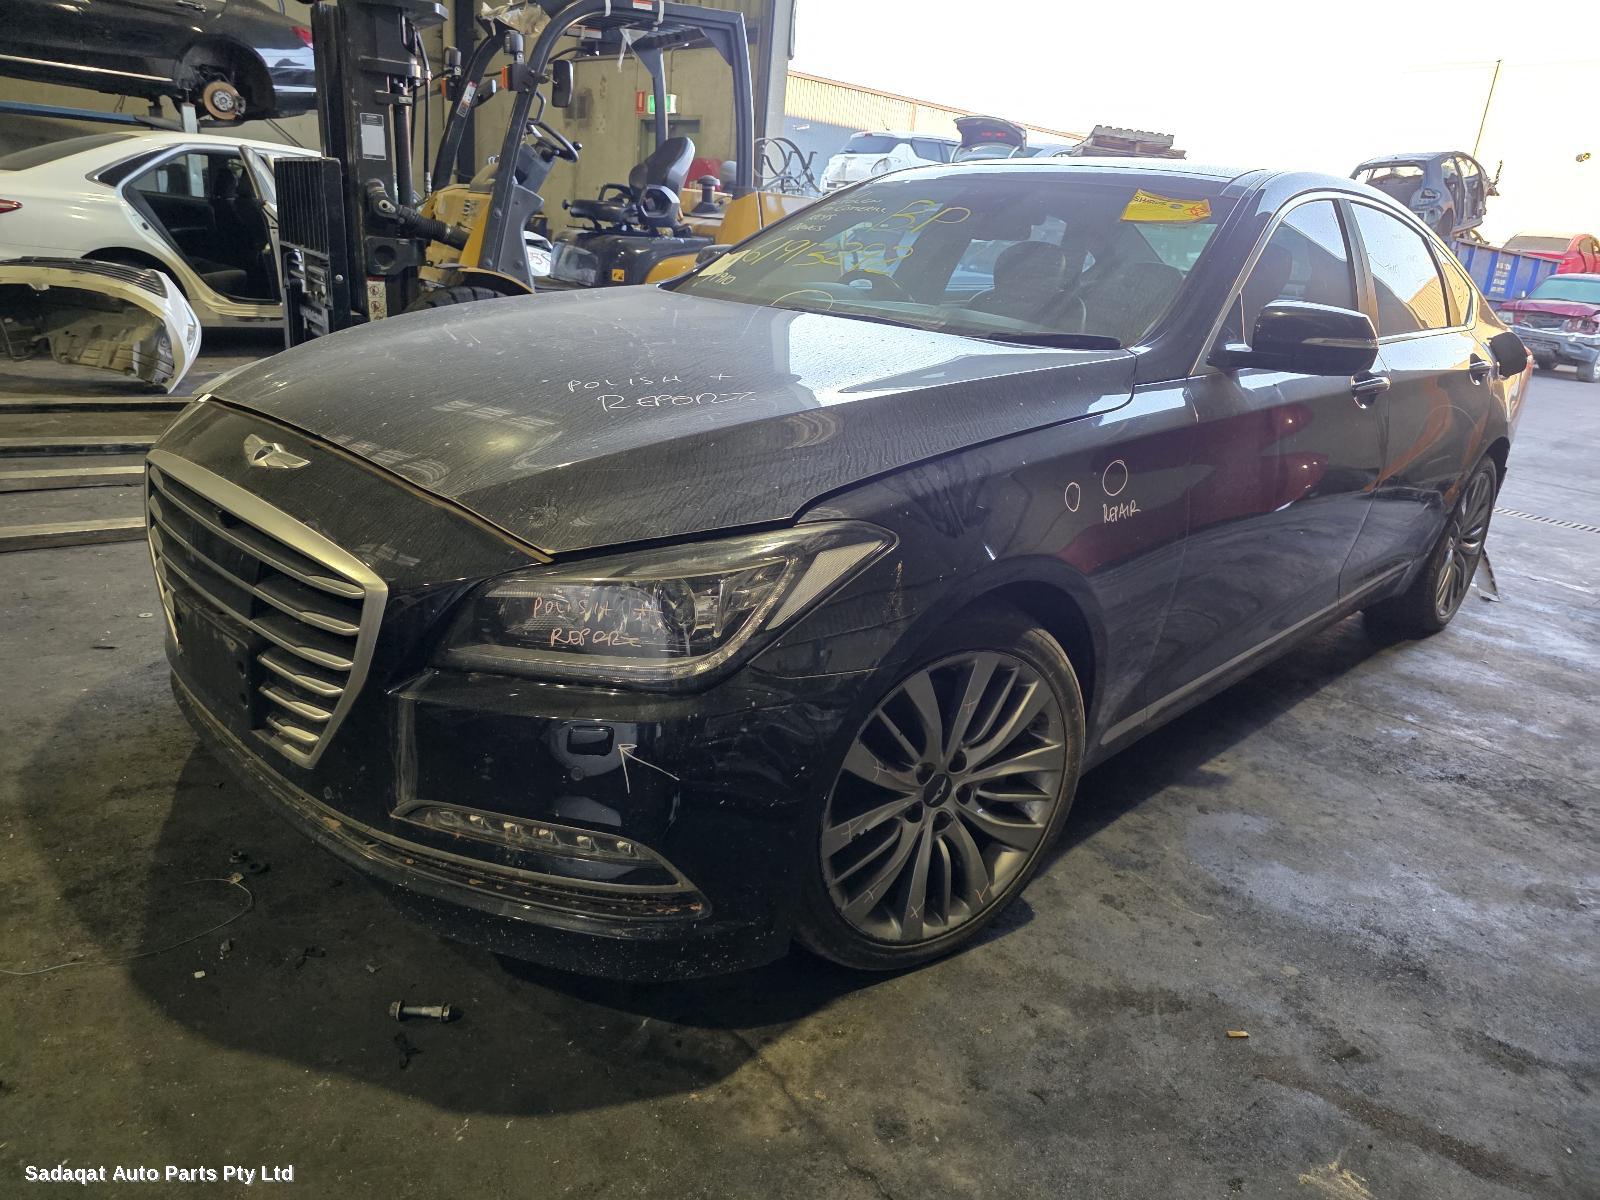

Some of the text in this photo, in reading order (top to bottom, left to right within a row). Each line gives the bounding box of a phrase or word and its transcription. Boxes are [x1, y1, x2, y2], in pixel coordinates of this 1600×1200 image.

[567, 375, 683, 392] POLISH
[1102, 499, 1142, 523] REPAIR
[532, 597, 613, 618] POLISH
